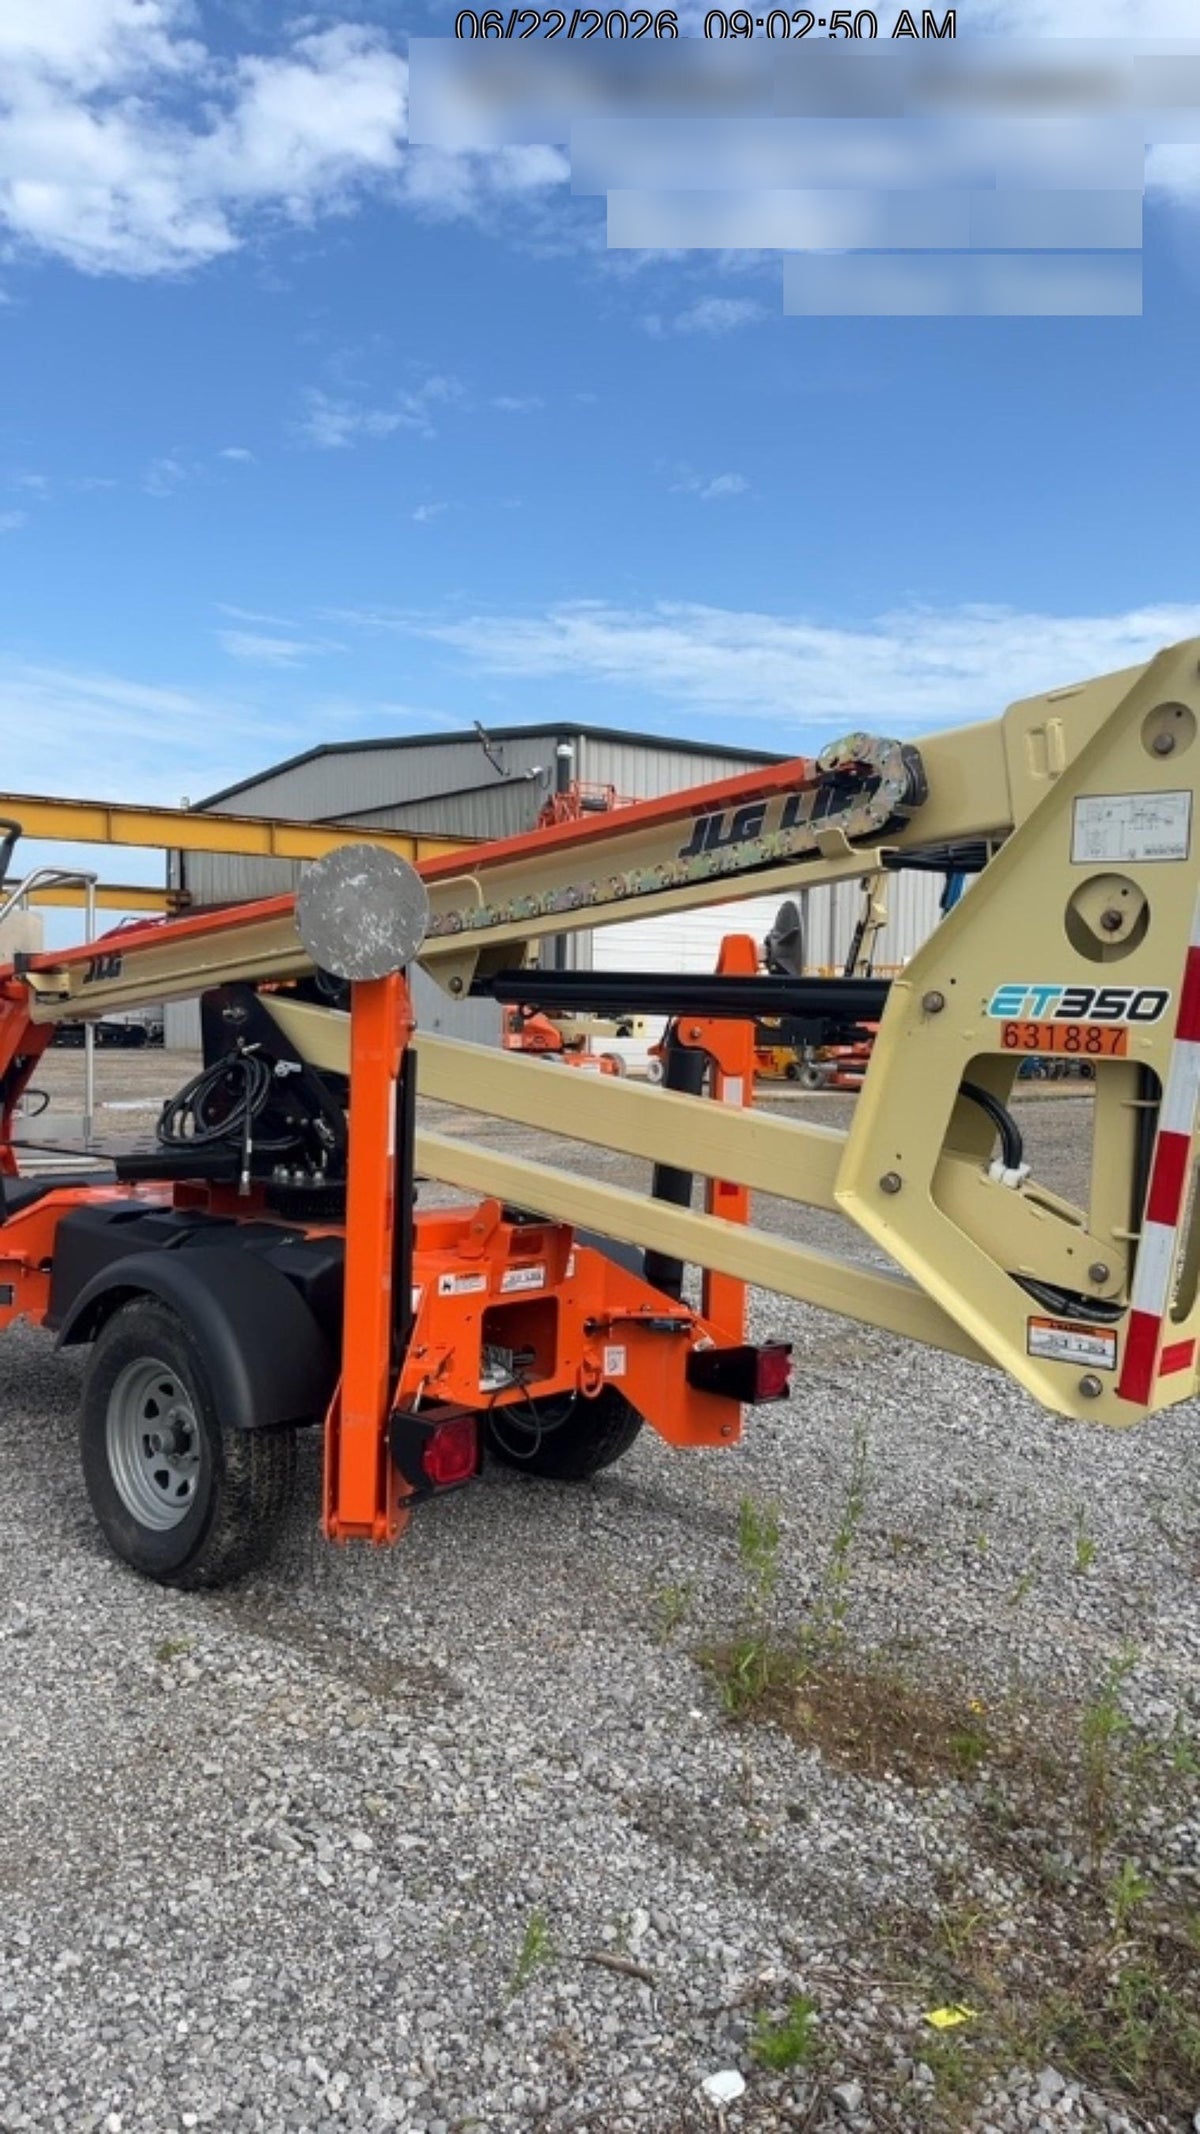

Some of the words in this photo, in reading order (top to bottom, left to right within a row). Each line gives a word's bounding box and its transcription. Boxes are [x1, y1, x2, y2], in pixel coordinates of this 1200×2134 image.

[680, 803, 768, 858] JLG
[82, 954, 123, 984] JLG
[988, 984, 1171, 1023] ET350
[1004, 1022, 1124, 1056] 631887
